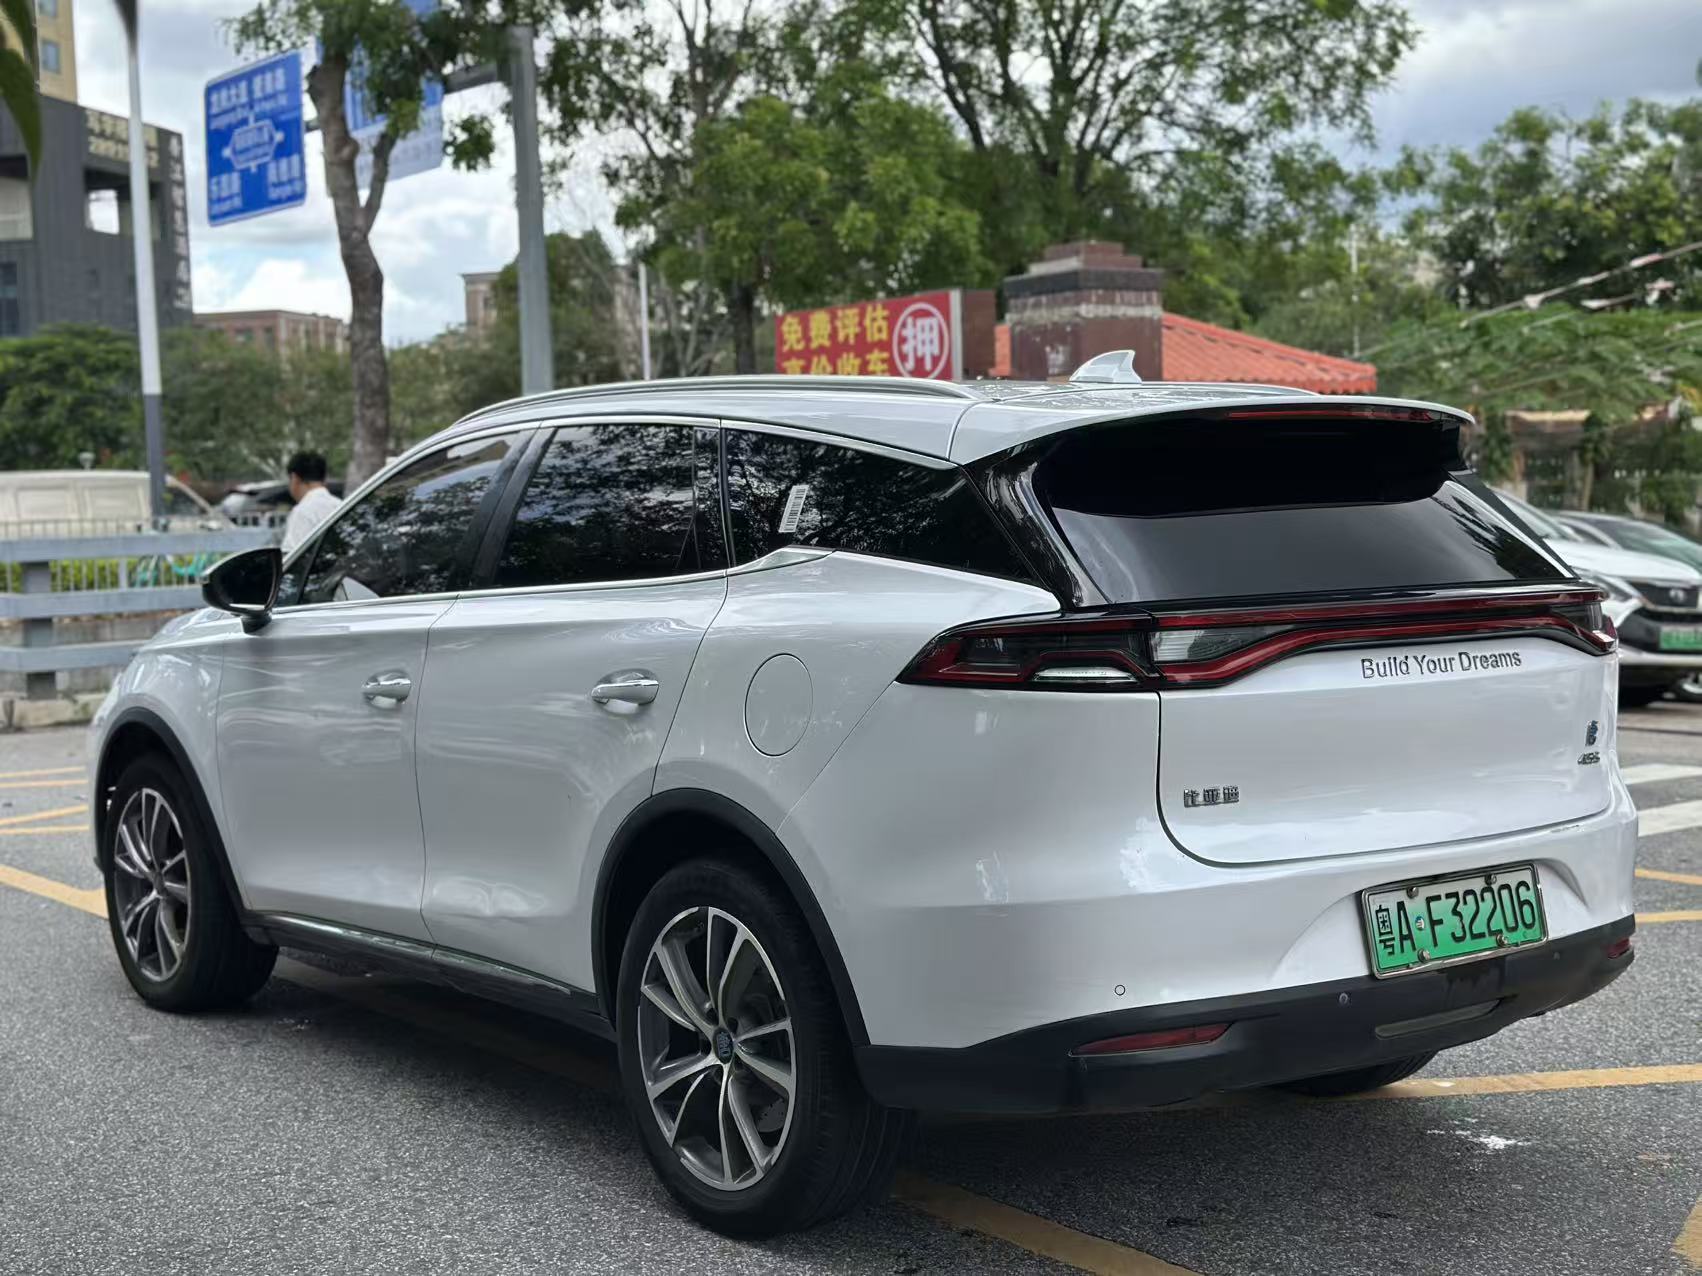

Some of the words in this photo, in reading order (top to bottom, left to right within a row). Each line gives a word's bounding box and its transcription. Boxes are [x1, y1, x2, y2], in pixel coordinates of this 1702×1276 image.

[781, 303, 889, 352] 免费评估
[902, 316, 939, 372] 押
[1361, 655, 1409, 679] Build
[1413, 654, 1456, 675] Your
[1458, 650, 1522, 671] Dreams
